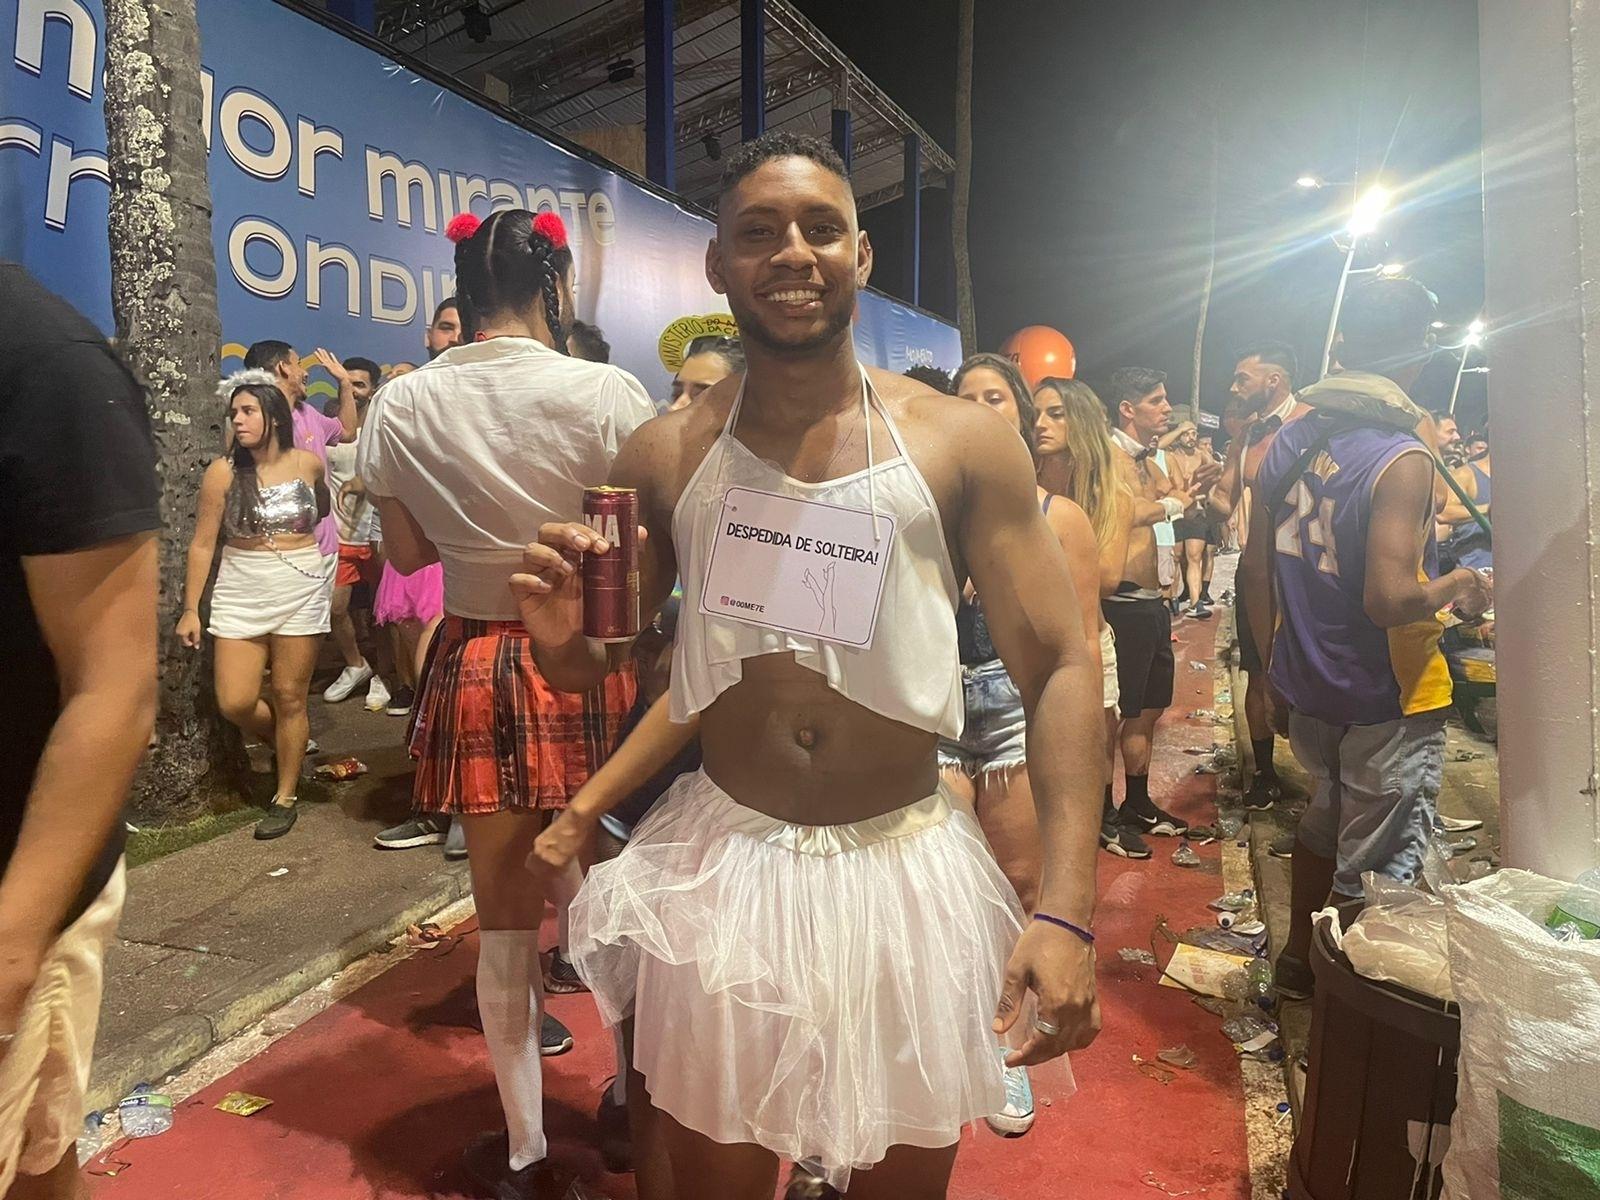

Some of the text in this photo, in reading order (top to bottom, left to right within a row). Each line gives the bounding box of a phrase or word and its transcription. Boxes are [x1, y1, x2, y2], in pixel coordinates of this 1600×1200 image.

[726, 522, 879, 566] DESPEDIDA DE SOLTEIRA!
[1275, 479, 1341, 577] 24
